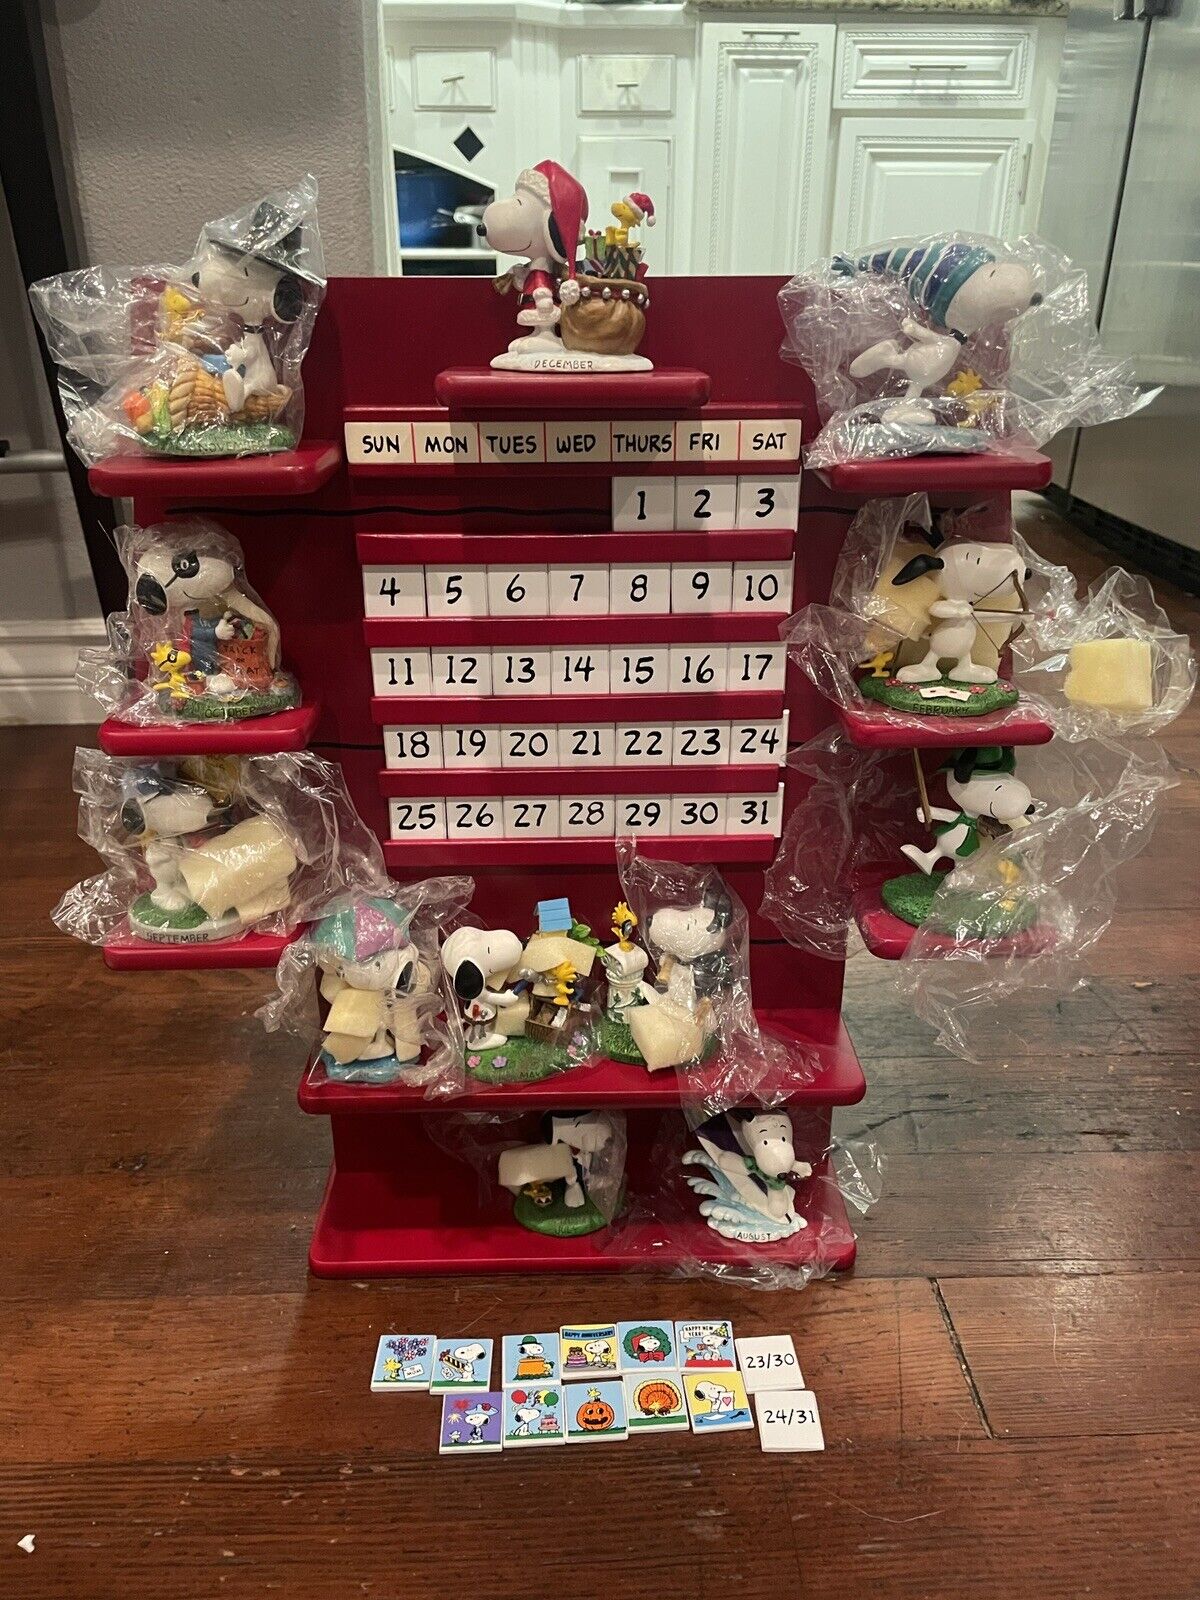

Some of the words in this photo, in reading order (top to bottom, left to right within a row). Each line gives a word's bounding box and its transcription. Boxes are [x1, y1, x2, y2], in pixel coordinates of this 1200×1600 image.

[533, 359, 593, 370] DECEMBER
[362, 434, 400, 454] SUN
[425, 435, 468, 454] MON
[485, 435, 537, 455] TUES
[556, 434, 597, 454] WED
[613, 433, 673, 454] THURS
[689, 432, 720, 451] FRI
[752, 432, 788, 451] SAT
[637, 490, 647, 521] 1
[693, 488, 712, 519] 2
[755, 487, 775, 518] 3
[379, 577, 401, 607] 4
[445, 575, 463, 605] 5
[506, 573, 526, 603] 6
[569, 574, 585, 602] 7
[629, 574, 648, 603] 8
[691, 571, 710, 600] 9
[745, 573, 779, 602] 10
[388, 657, 415, 686] 11
[445, 655, 478, 684] 12
[504, 655, 536, 684] 13
[563, 655, 596, 683] 14
[622, 656, 655, 685] 15
[681, 654, 715, 684] 16
[741, 653, 774, 681] 17
[204, 706, 257, 719] OCTOBER
[912, 703, 970, 715] FEBRUARY
[396, 730, 430, 759] 18
[455, 729, 487, 758] 19
[509, 731, 549, 757] 20
[571, 730, 602, 756] 21
[624, 729, 663, 756] 22
[680, 727, 721, 755] 23
[739, 727, 780, 754] 24
[396, 803, 436, 831] 25
[455, 802, 494, 828] 26
[513, 803, 547, 828] 27
[568, 801, 605, 826] 28
[625, 802, 661, 827] 29
[680, 801, 719, 825] 30
[740, 800, 769, 825] 31
[146, 932, 209, 944] SEPTEMBER
[736, 1231, 771, 1241] AUGUST
[745, 1353, 795, 1369] 23/30
[764, 1408, 816, 1426] 24/31
